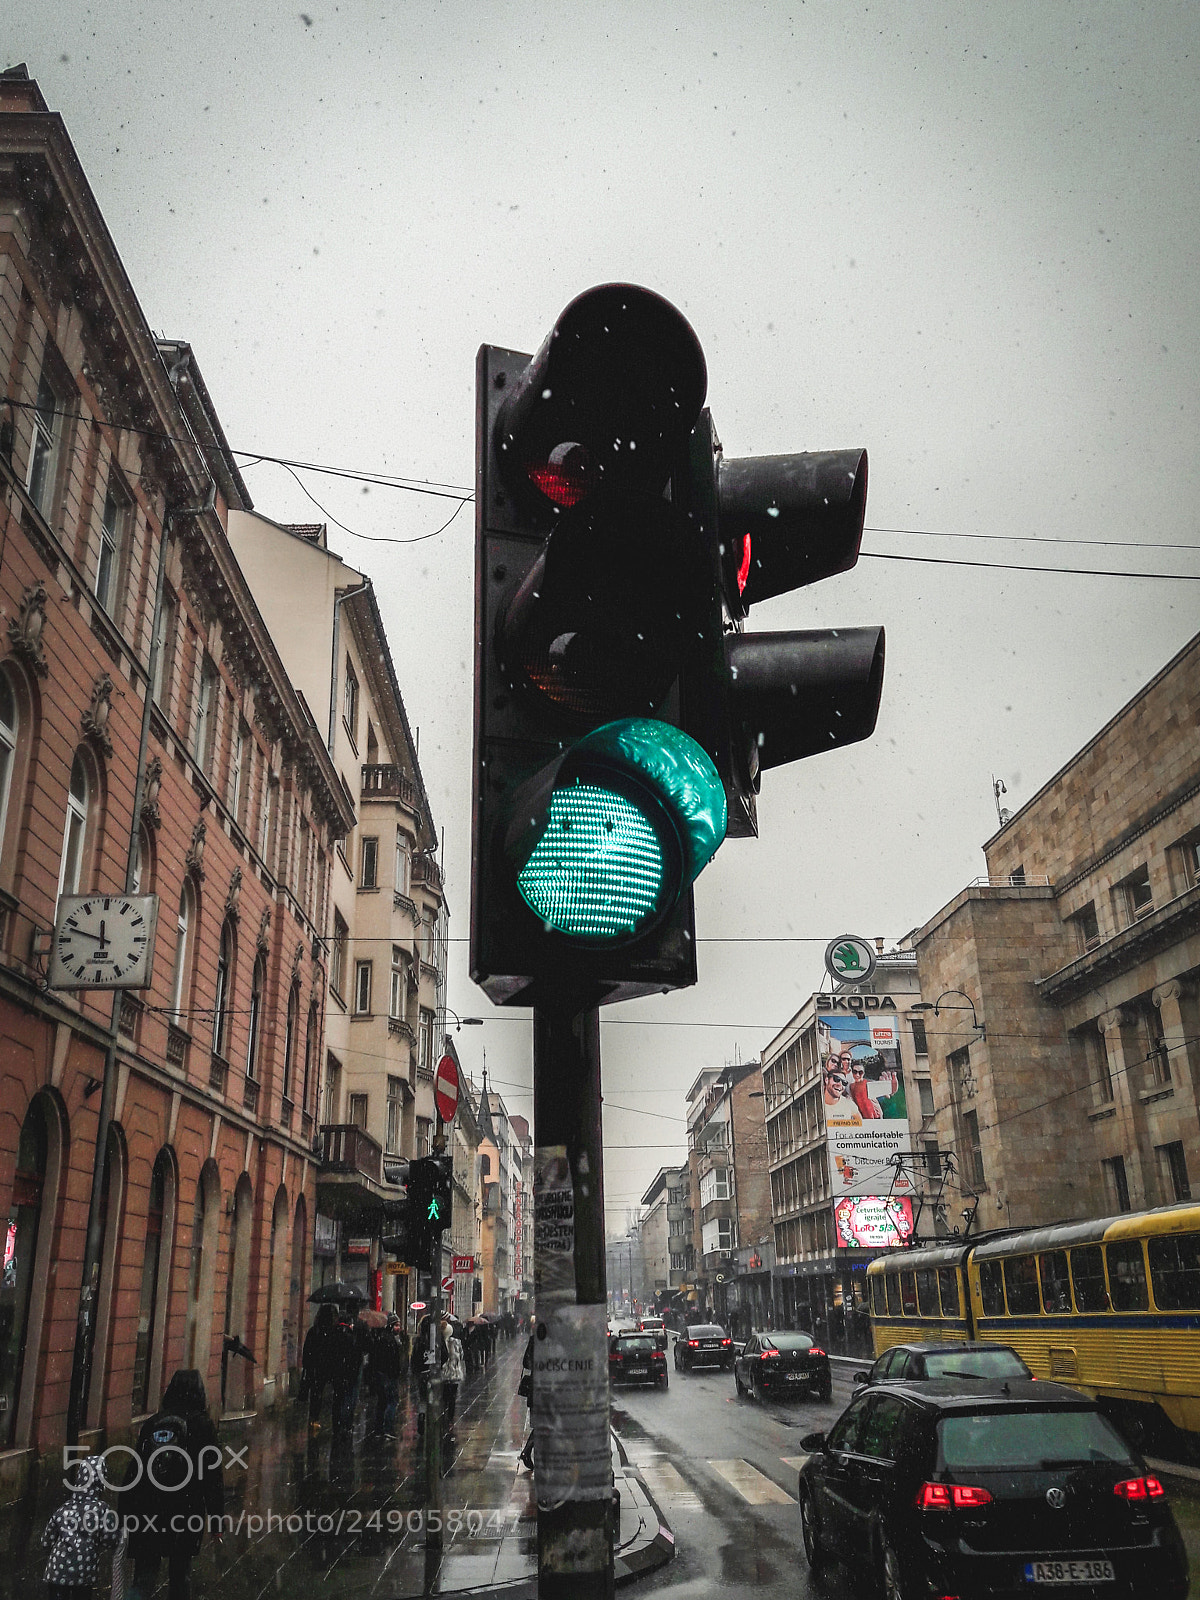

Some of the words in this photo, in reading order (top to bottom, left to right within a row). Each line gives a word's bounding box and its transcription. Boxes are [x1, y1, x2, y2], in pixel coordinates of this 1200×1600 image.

[854, 1131, 904, 1139] comfortable
[836, 1141, 899, 1149] communication
[854, 1157, 884, 1165] Discover
[864, 1213, 887, 1221] igrajte
[1036, 1562, 1112, 1580] A38-E-186
